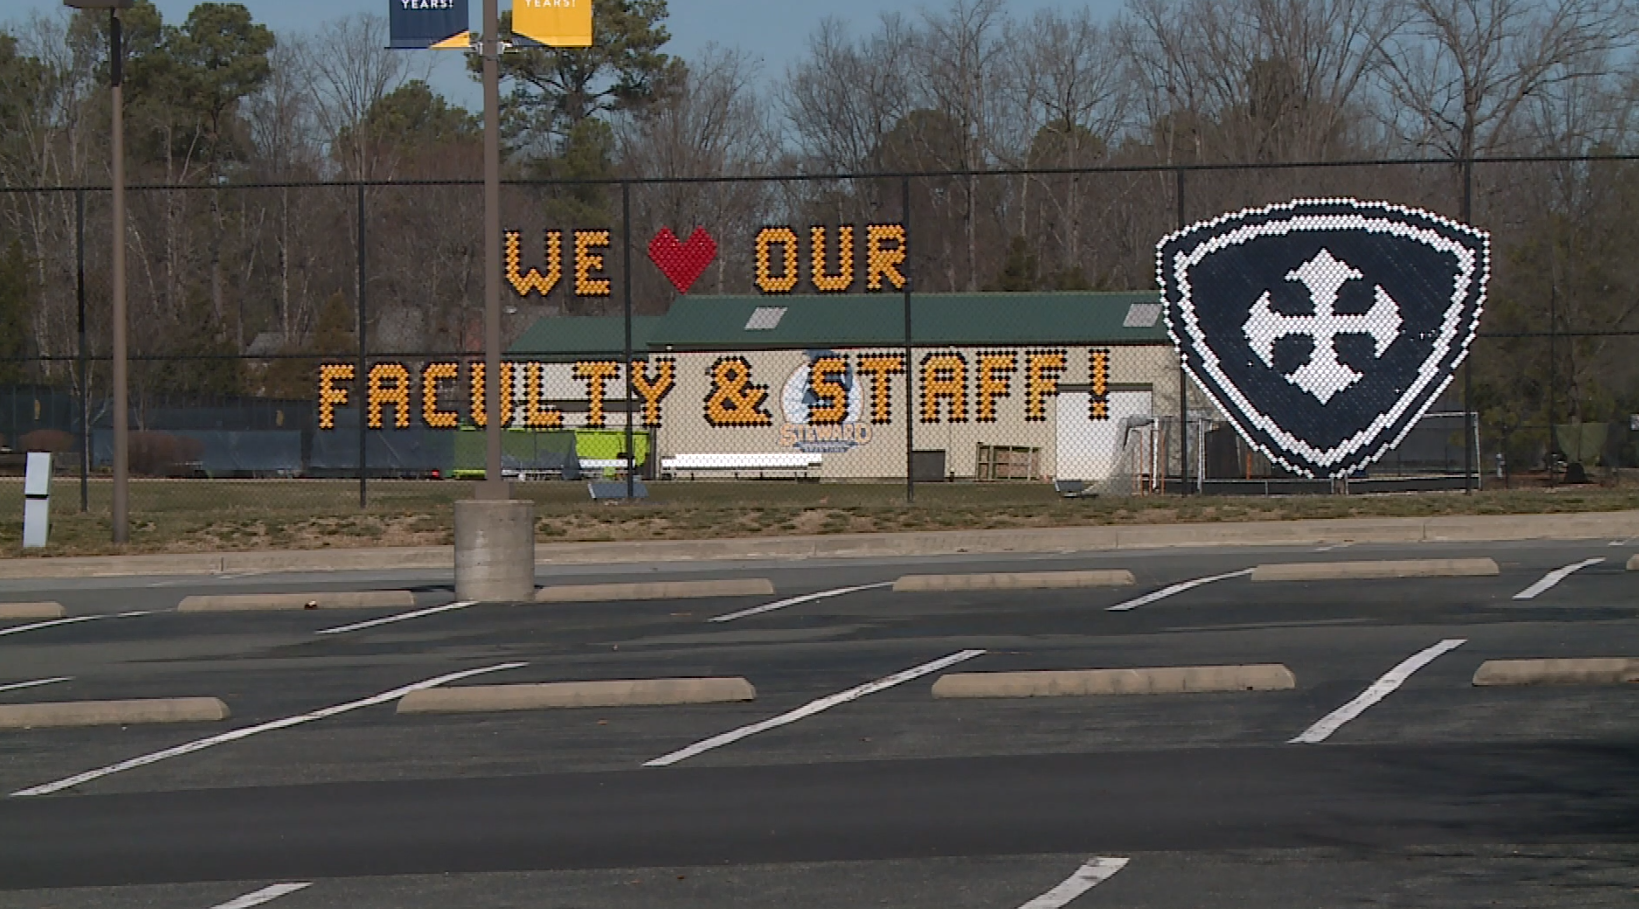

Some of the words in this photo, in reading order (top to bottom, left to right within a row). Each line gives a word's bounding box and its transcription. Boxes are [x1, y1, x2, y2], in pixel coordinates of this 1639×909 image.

[402, 0, 454, 9] YEARS!
[525, 0, 576, 8] YEARS!
[503, 228, 612, 297] WE
[753, 223, 908, 295] OUR
[317, 358, 676, 430] FACULTY
[704, 355, 773, 428] &
[779, 422, 873, 447] STEWARD
